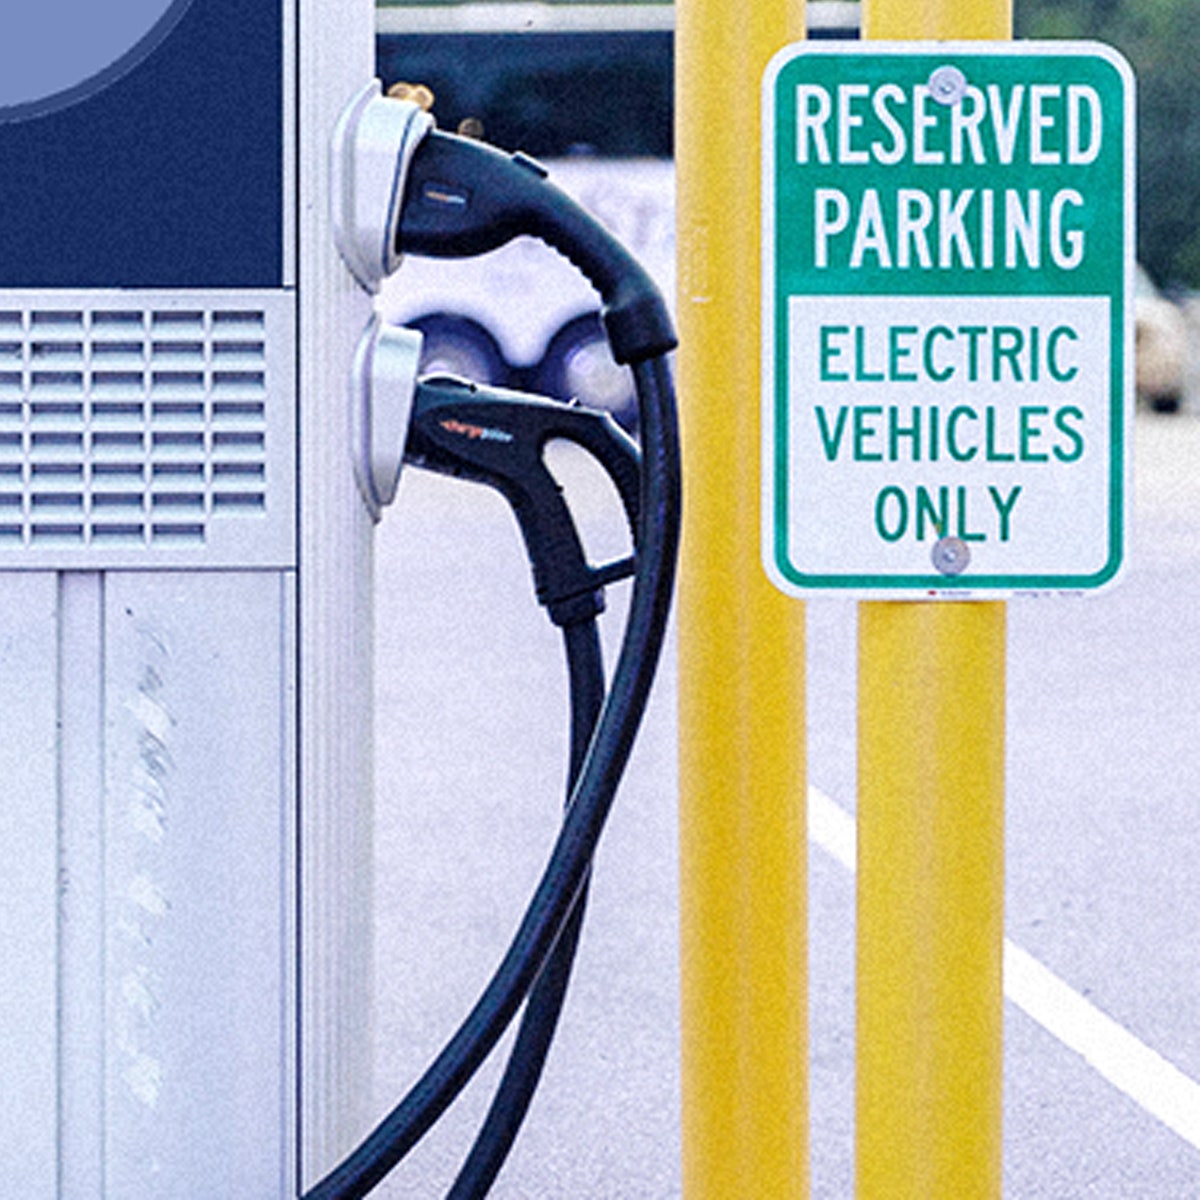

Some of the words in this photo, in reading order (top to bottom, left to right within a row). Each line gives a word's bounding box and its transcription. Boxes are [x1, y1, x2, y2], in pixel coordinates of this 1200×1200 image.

[795, 83, 1103, 165] RESERVED
[814, 187, 1086, 270] PARKING
[819, 325, 1080, 382] ELECTRIC
[814, 405, 1086, 463] VEHICLES
[874, 485, 1023, 543] ONLY
